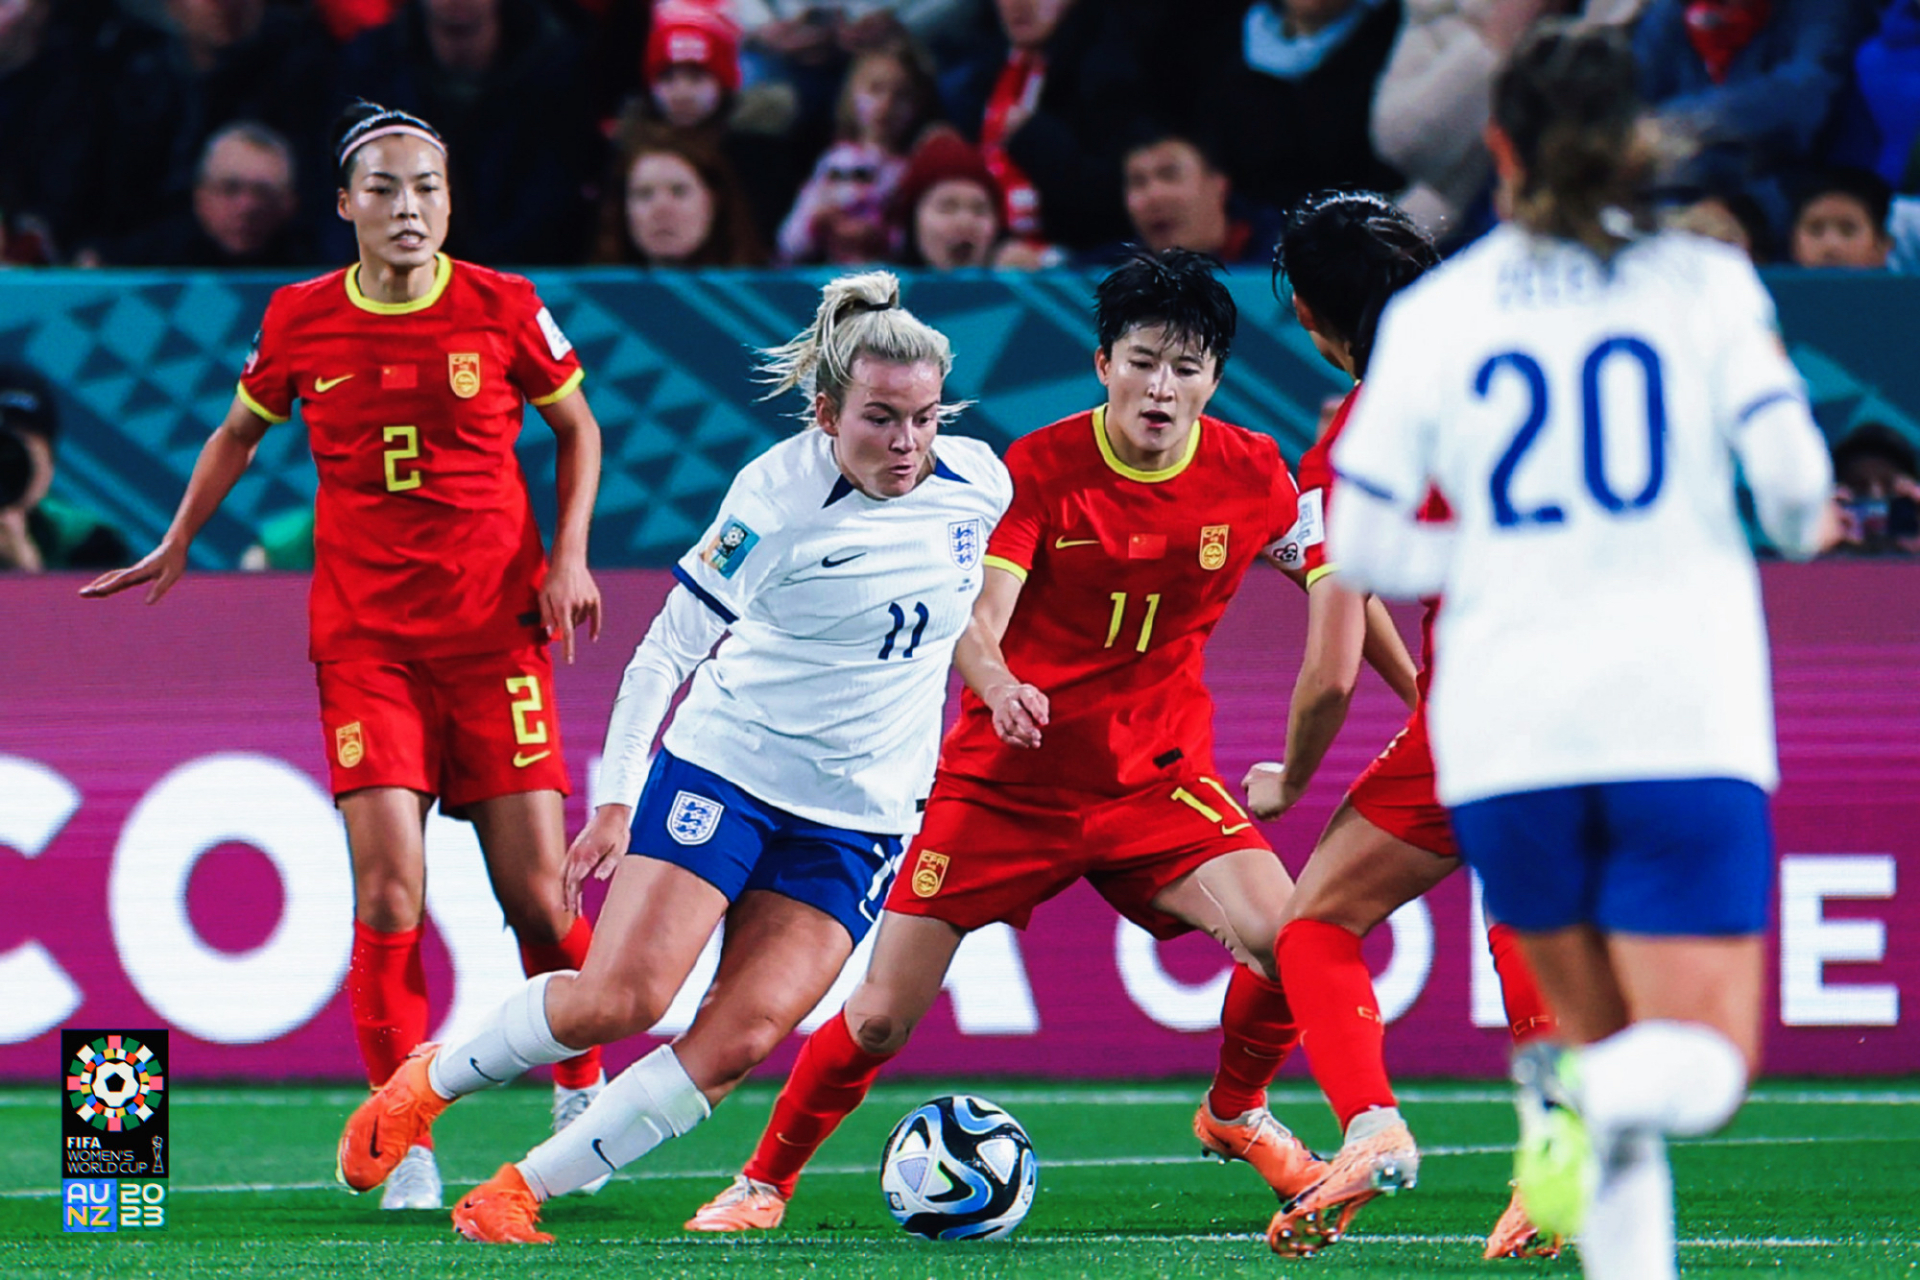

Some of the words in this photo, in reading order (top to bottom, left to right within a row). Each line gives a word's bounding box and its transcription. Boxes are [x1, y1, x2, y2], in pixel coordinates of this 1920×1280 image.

[383, 425, 422, 492] 2
[1474, 337, 1667, 525] 20
[878, 601, 929, 661] 11
[1104, 592, 1160, 653] 11
[506, 675, 547, 744] 2
[1170, 776, 1248, 824] 11
[1512, 1015, 1561, 1036] CF
